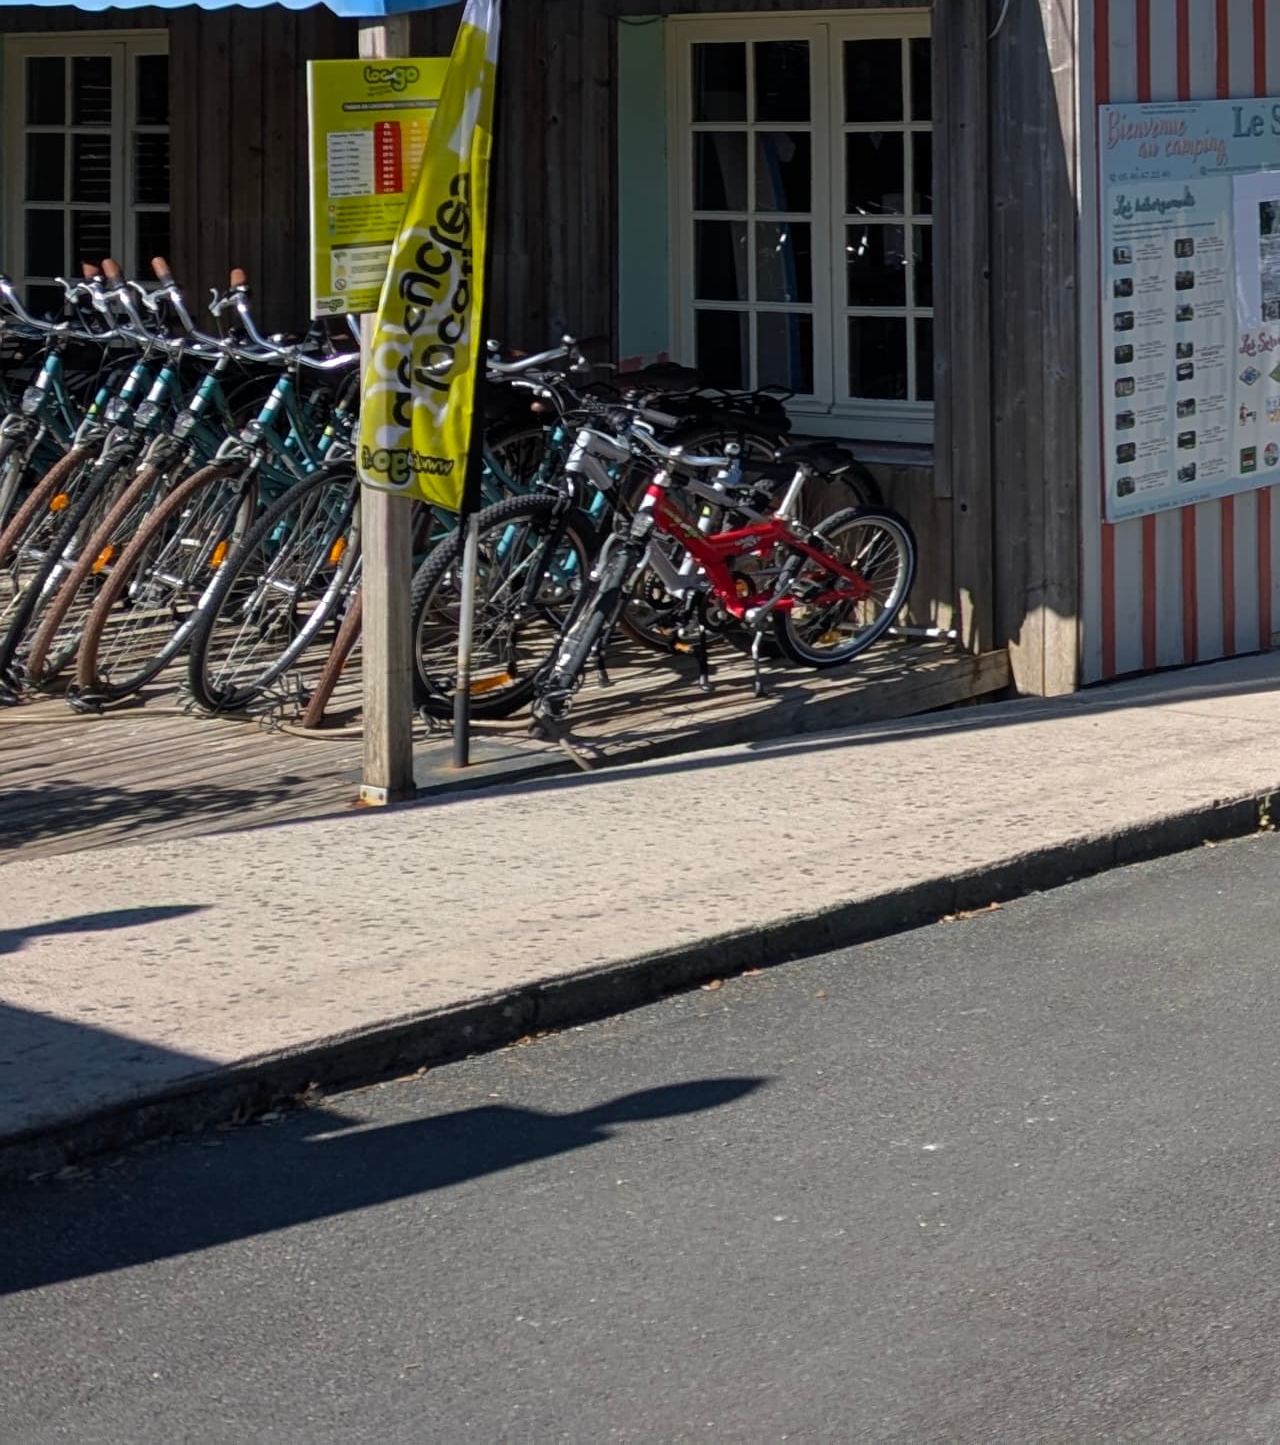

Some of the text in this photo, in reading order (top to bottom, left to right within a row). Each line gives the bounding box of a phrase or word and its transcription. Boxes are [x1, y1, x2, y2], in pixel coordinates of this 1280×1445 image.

[1106, 110, 1186, 149] Bienvenue
[1232, 107, 1264, 138] Le
[1138, 130, 1228, 166] au camping
